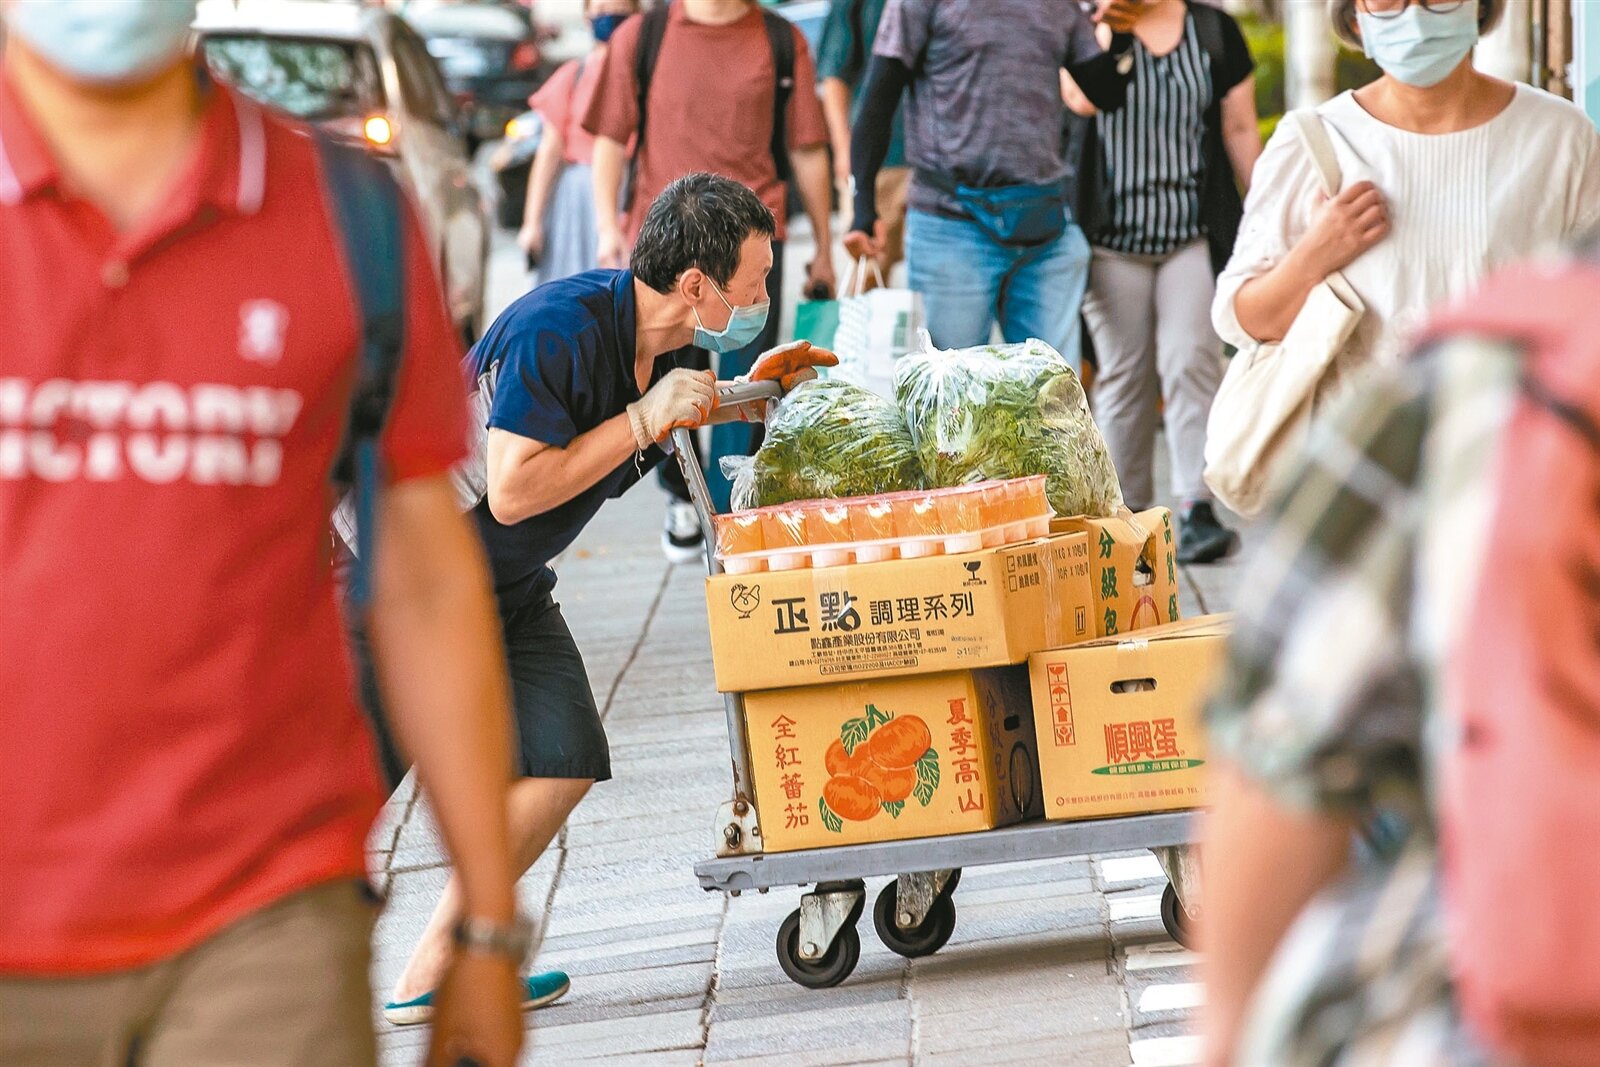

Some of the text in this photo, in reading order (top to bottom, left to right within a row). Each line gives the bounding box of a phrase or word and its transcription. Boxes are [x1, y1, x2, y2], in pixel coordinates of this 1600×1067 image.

[772, 591, 975, 634] 正點 調理系列
[771, 714, 808, 829] 全紅蕃茄
[946, 697, 984, 814] 夏季高山
[1104, 718, 1179, 764] 順興蛋
